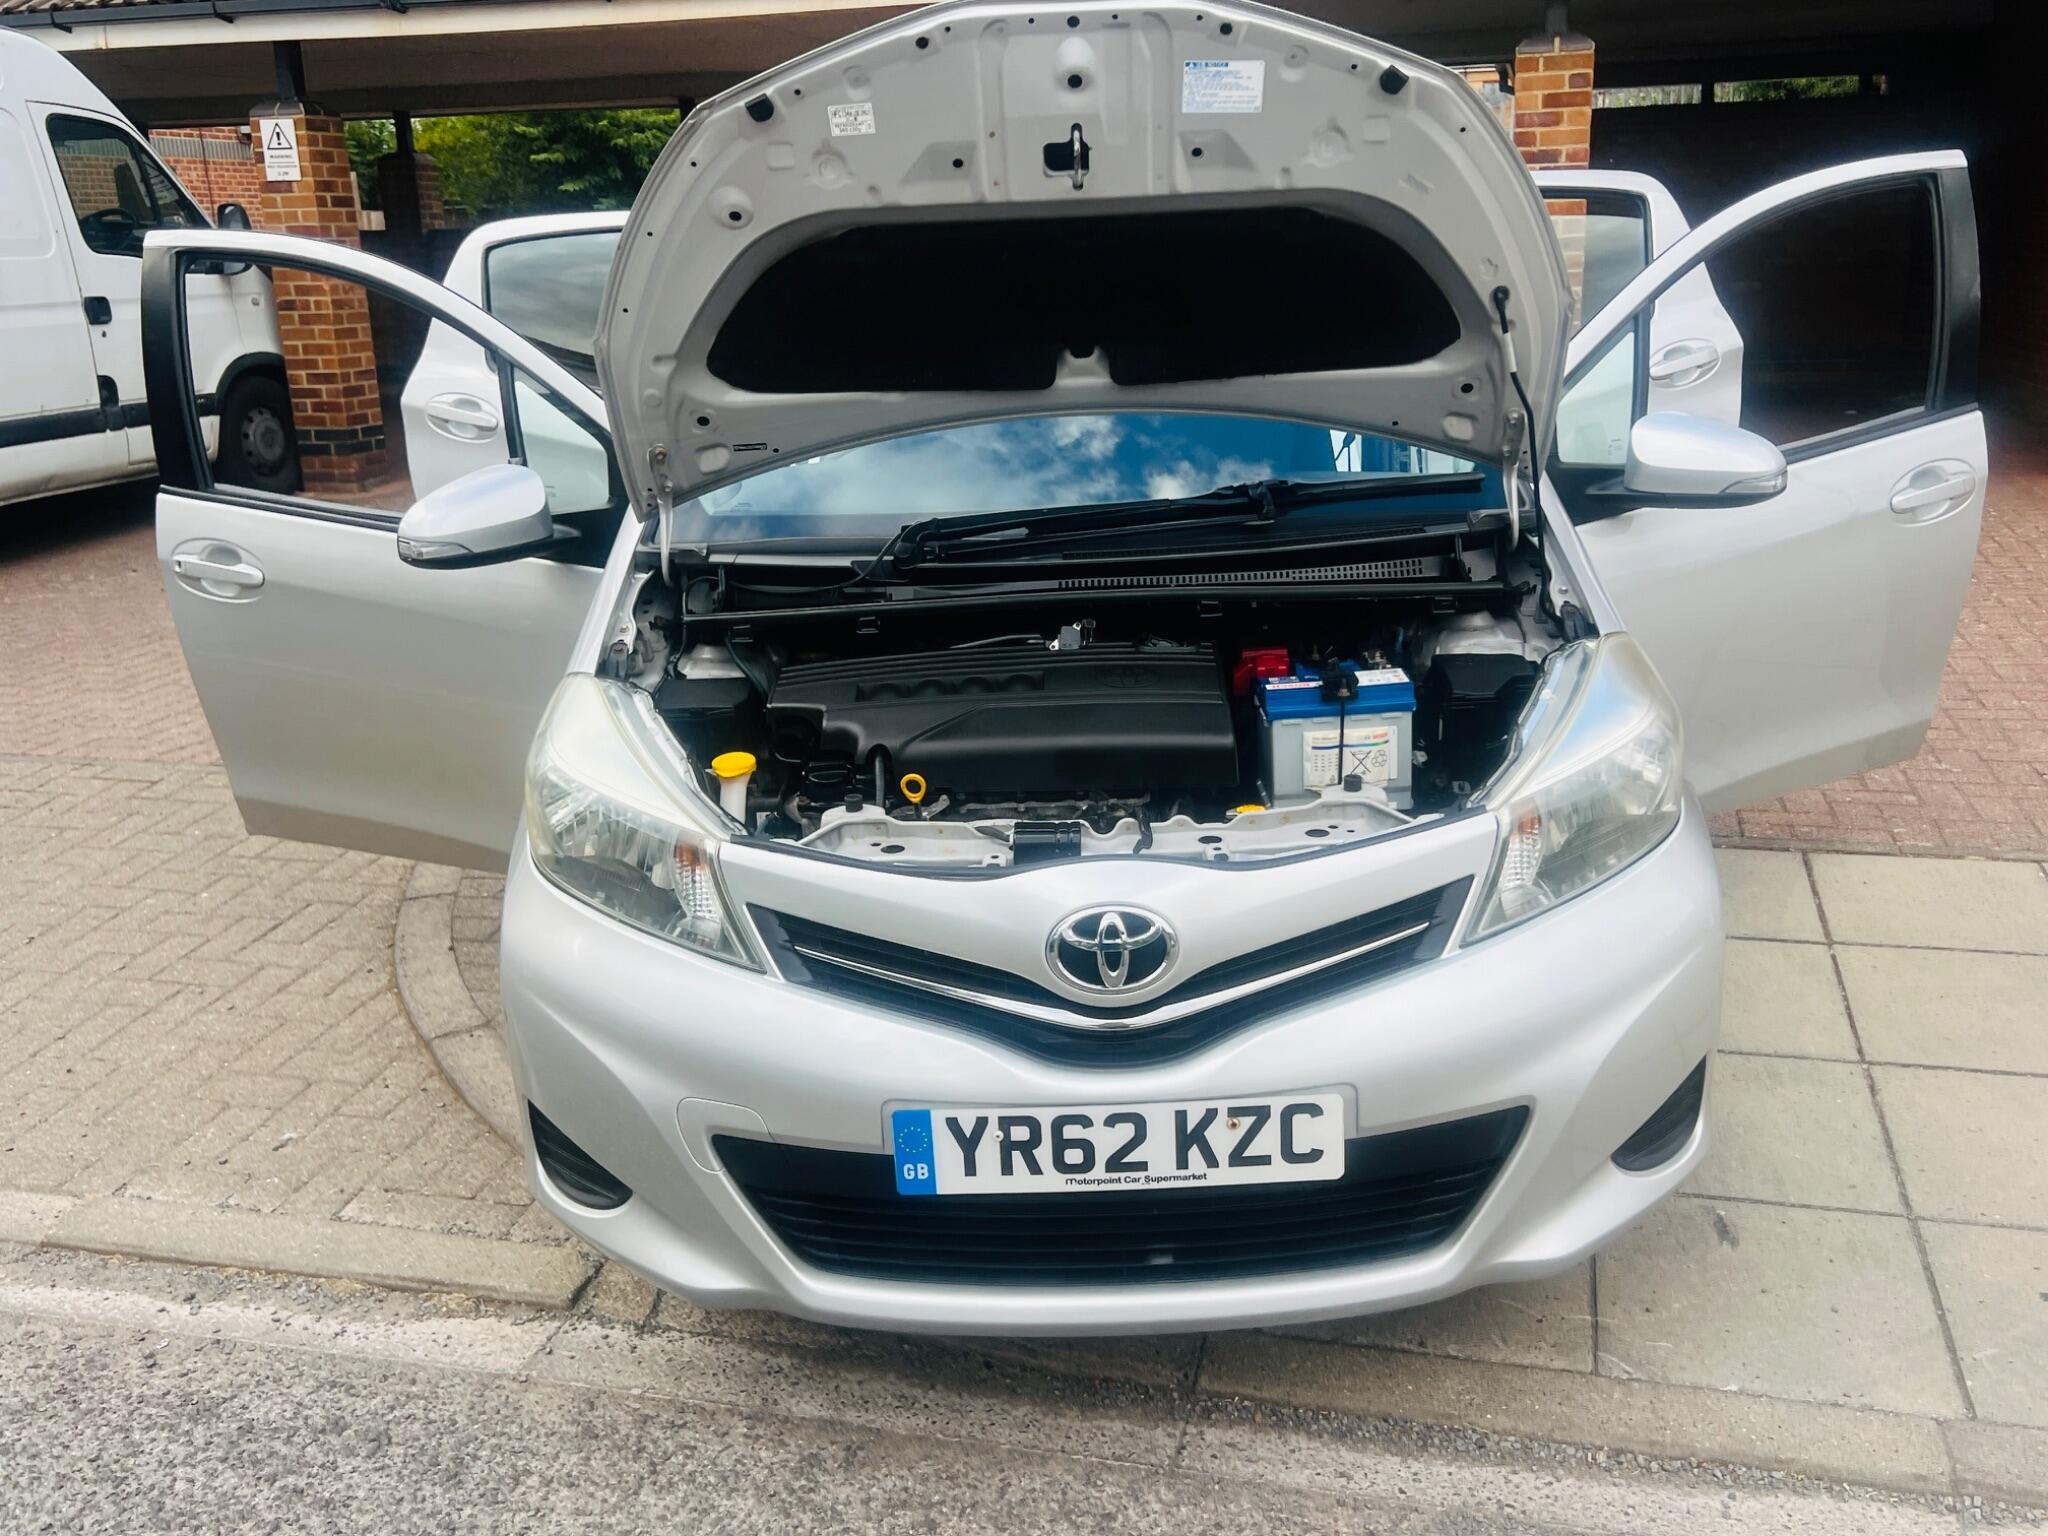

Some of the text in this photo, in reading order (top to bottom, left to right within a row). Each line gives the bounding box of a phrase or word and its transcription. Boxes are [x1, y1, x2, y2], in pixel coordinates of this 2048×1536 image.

[945, 1102, 1324, 1177] YR62 KZC
[903, 1163, 929, 1180] GB
[1065, 1172, 1208, 1186] Motorpoint Car Supermarket
